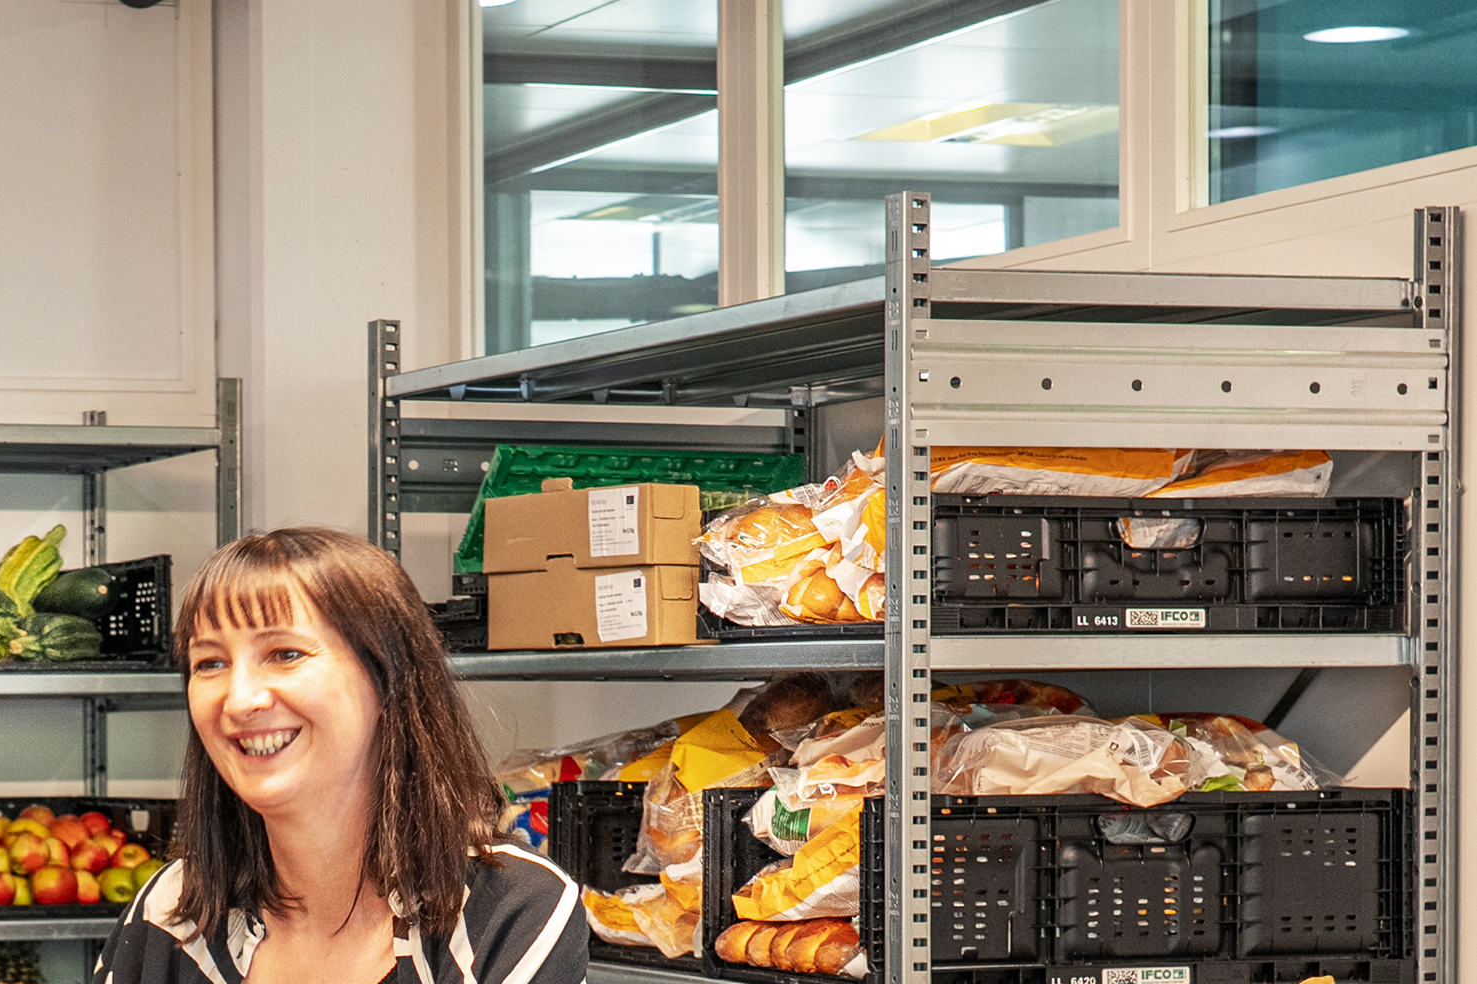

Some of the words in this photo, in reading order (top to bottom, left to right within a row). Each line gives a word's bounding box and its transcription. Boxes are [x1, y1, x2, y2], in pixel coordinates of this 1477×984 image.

[1076, 615, 1089, 626] LL
[1093, 615, 1119, 626] 6413
[1160, 611, 1189, 621] IFCO
[1141, 969, 1172, 980] IFCO
